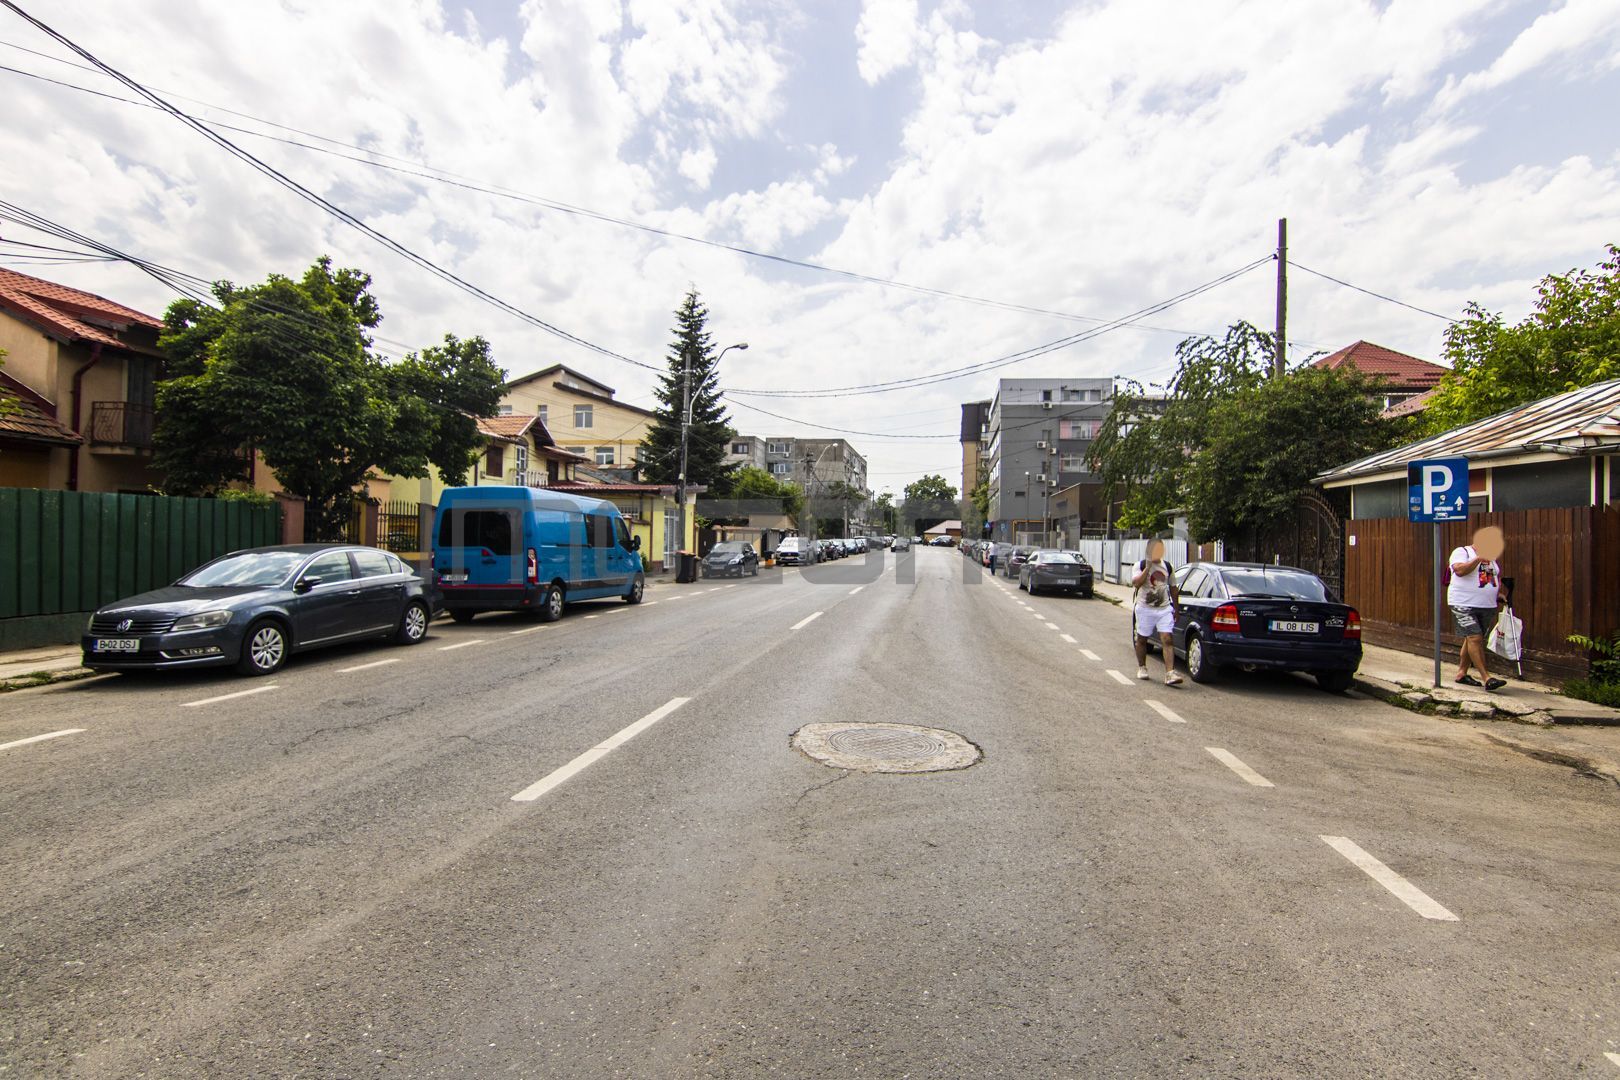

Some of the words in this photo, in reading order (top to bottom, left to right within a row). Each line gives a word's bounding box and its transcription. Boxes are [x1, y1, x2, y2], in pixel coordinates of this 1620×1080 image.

[1422, 465, 1454, 515] P
[1276, 622, 1284, 631] IL
[1286, 622, 1297, 631] 08
[1300, 623, 1315, 632] LIS
[99, 640, 106, 649] B
[107, 640, 118, 649] 02
[119, 640, 136, 649] DSJ
